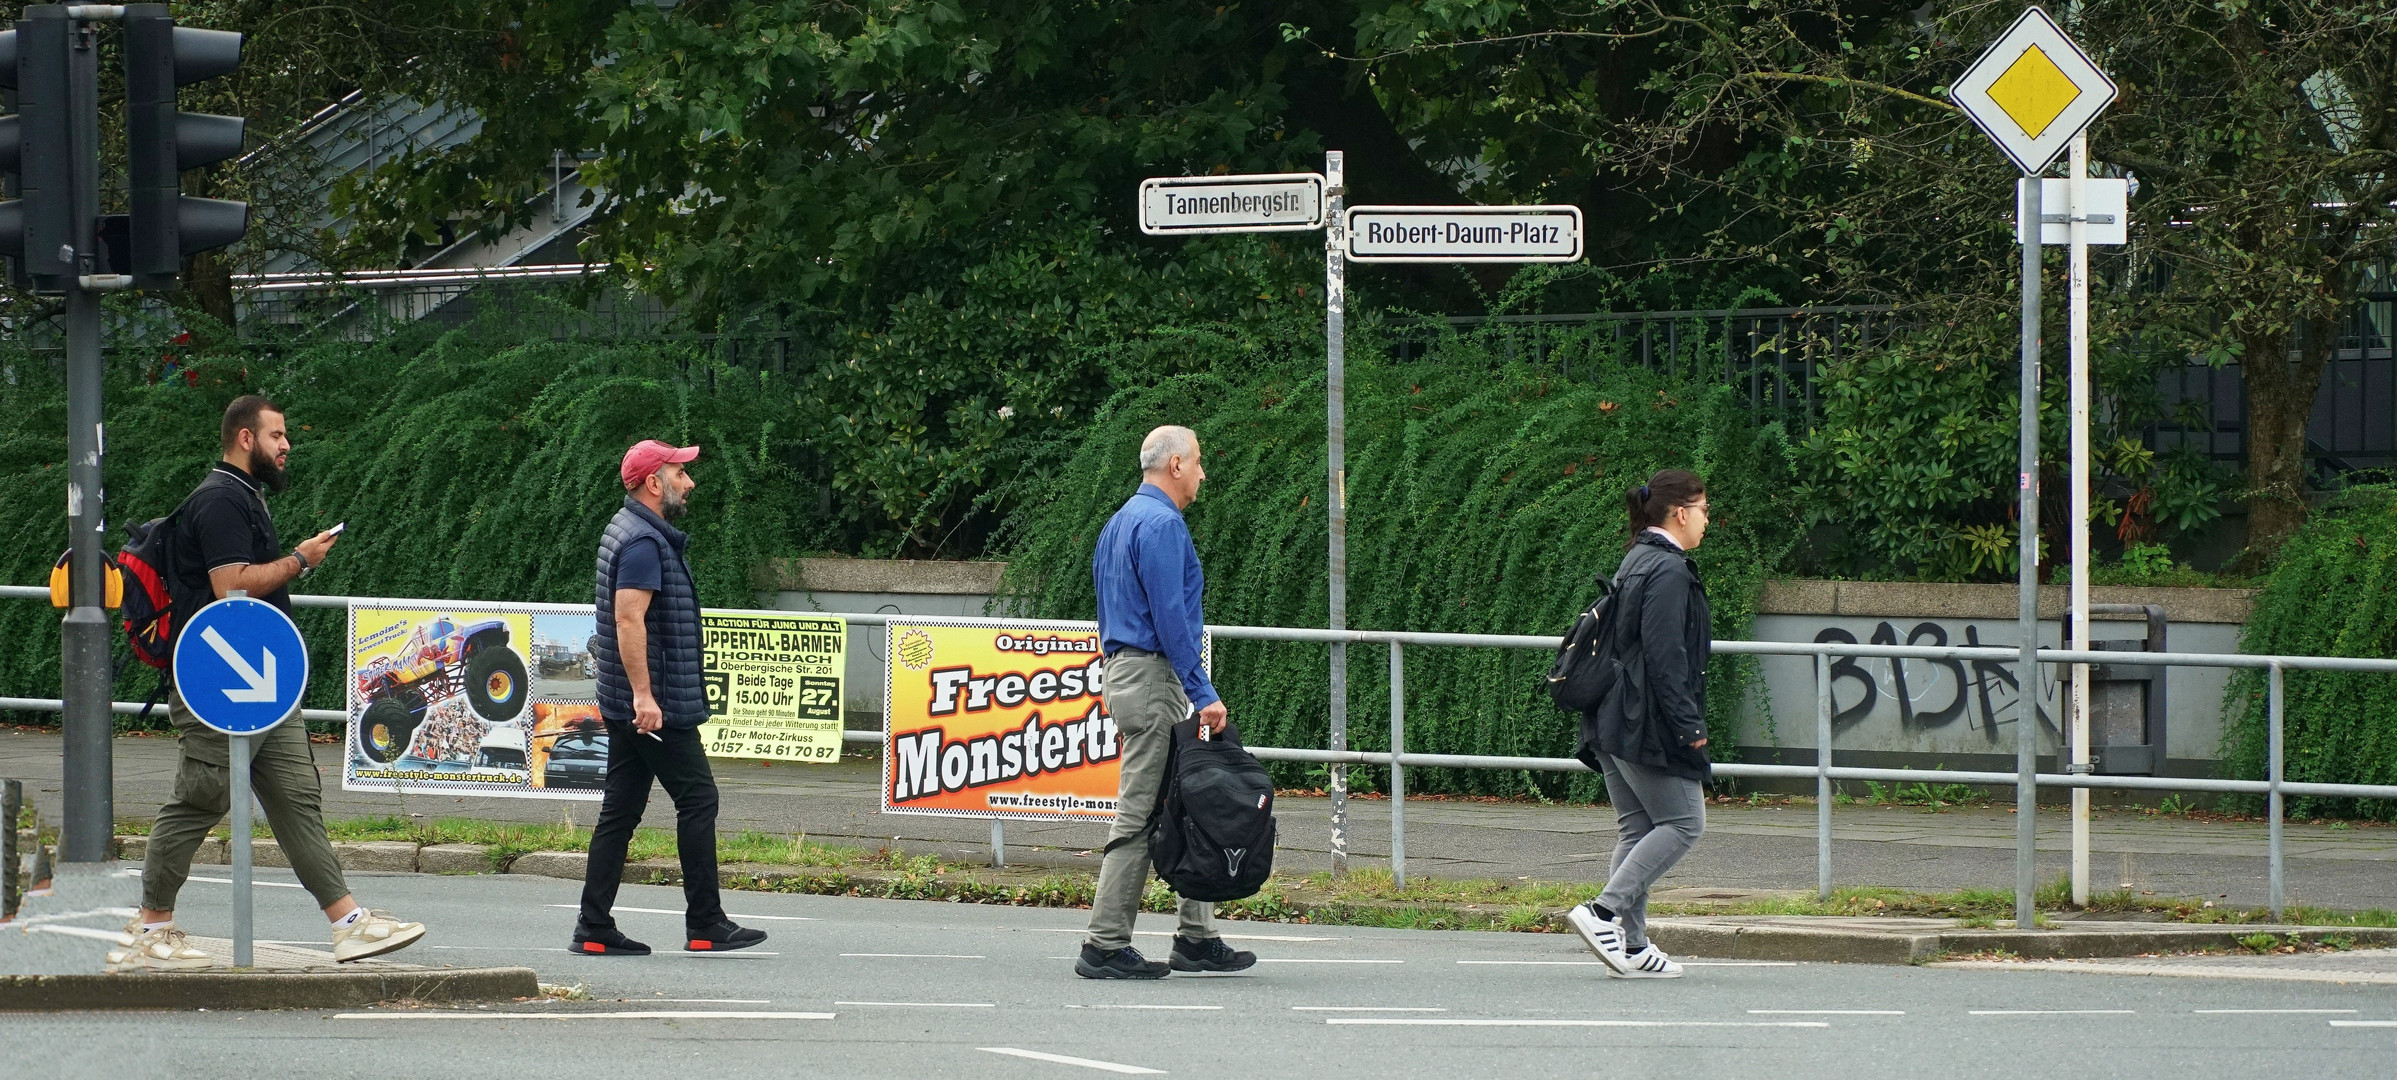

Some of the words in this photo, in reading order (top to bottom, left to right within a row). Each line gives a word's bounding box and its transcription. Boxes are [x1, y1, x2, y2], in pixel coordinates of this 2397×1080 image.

[1165, 192, 1299, 219] Tannenbergstr.
[1368, 222, 1559, 245] Robert-Daum-Platz
[708, 618, 715, 626] &
[717, 619, 750, 628] ACTION
[752, 618, 770, 628] FÜR
[771, 620, 797, 630] JUNG
[798, 621, 819, 631] UND
[821, 622, 840, 631] ALT
[358, 637, 384, 653] newest
[996, 635, 1097, 654] Original
[721, 651, 832, 664] HORNBACH
[720, 661, 793, 674] Oberbergische
[796, 664, 813, 674] Str.
[815, 666, 832, 674] 201
[737, 673, 766, 687] Beide
[769, 675, 794, 690] Tage
[804, 679, 836, 687] Sonntag
[930, 657, 1103, 714] Freest
[735, 690, 769, 705] 15.00
[772, 691, 794, 706] Uhr
[800, 688, 838, 706] 27.
[741, 708, 755, 716] Show
[768, 709, 775, 717] 90
[776, 710, 796, 718] Minuten
[807, 707, 831, 716] August
[732, 718, 752, 726] findet
[754, 719, 765, 727] bei
[765, 720, 783, 728] jeder
[785, 721, 819, 731] Witterung
[820, 722, 839, 730] statt!
[730, 730, 746, 739] Der
[748, 730, 813, 743] Motor-Zirkuss
[711, 741, 744, 753] 0157
[754, 744, 772, 754] 54
[775, 745, 791, 756] 61
[795, 746, 812, 757] 70
[816, 747, 835, 758] 87
[894, 704, 1119, 800] Monstertr
[355, 768, 523, 783] www.freestyle-monstertruck.de
